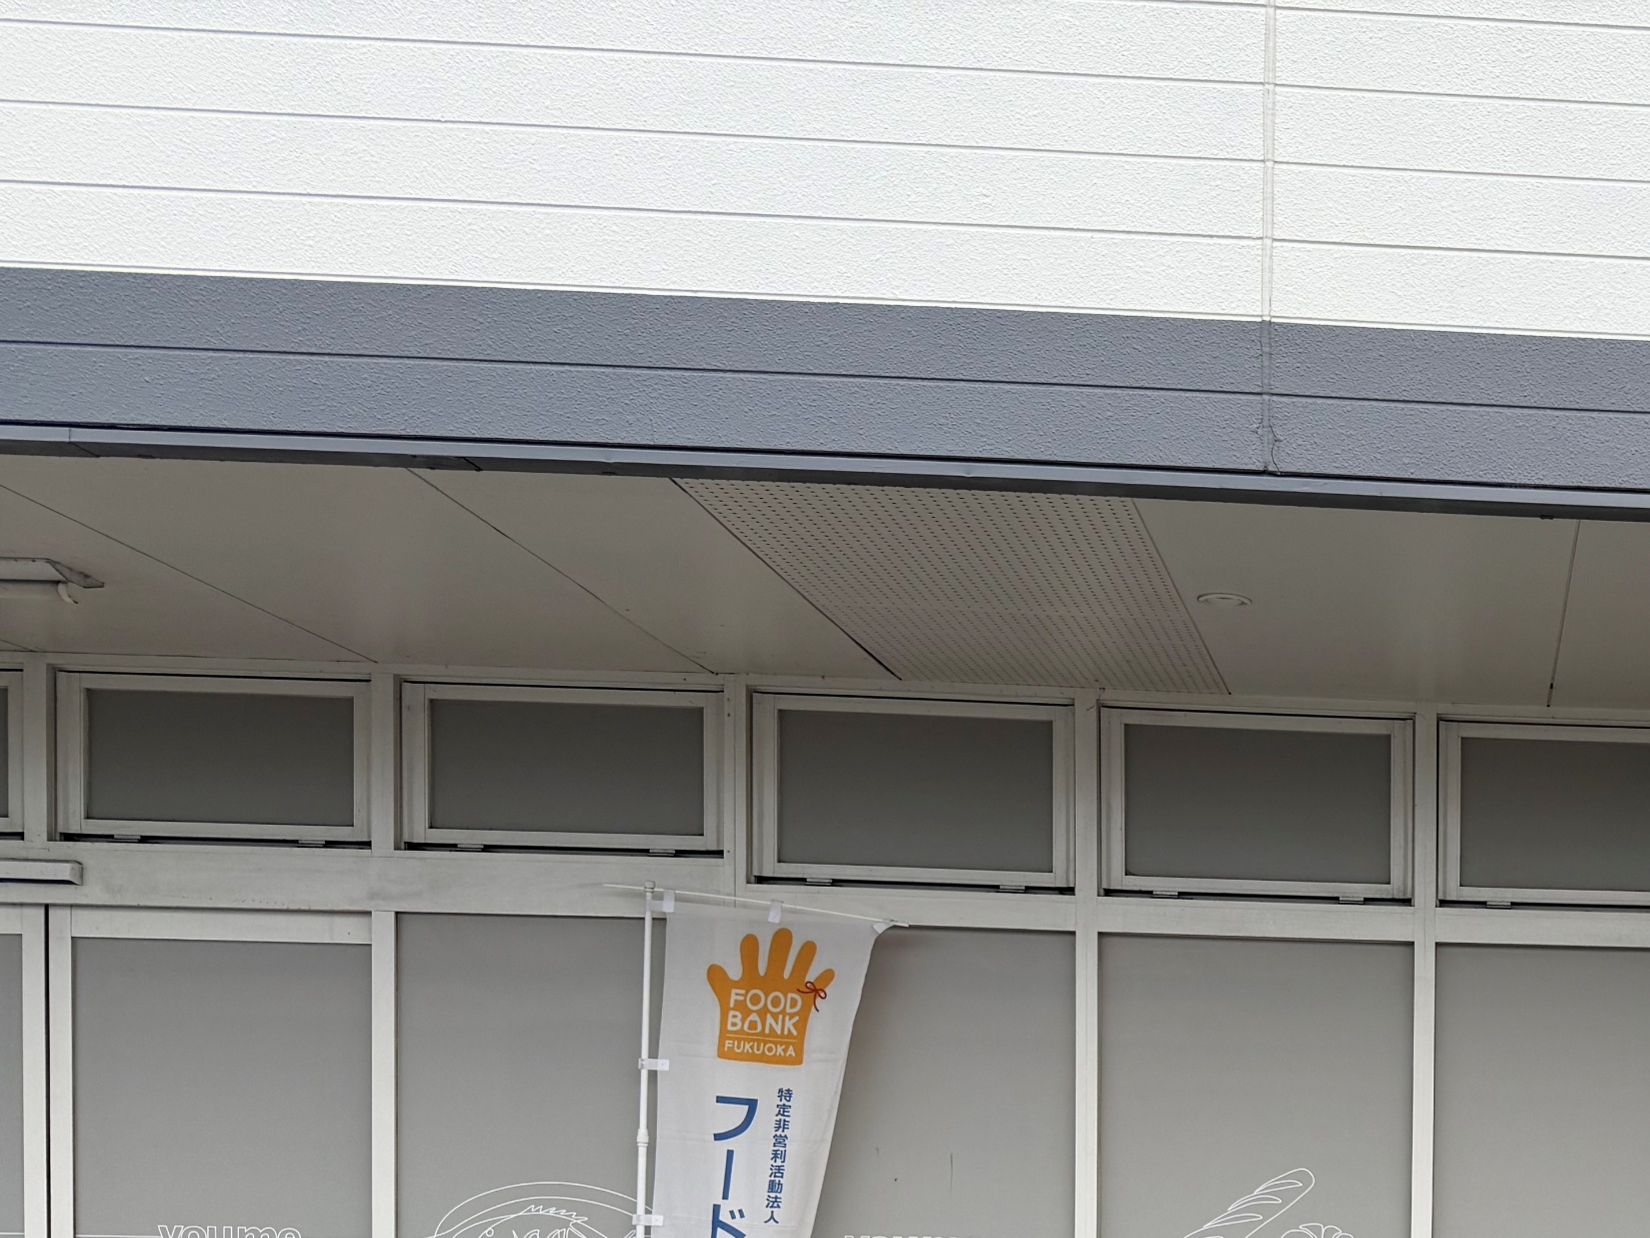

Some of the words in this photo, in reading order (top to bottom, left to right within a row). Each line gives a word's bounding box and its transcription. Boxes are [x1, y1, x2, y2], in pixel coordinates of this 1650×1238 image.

[730, 989, 802, 1013] FOOD
[727, 1010, 799, 1036] BANK
[725, 1040, 796, 1057] FUKUOKA
[764, 1087, 793, 1224] 特定非営利活動法人
